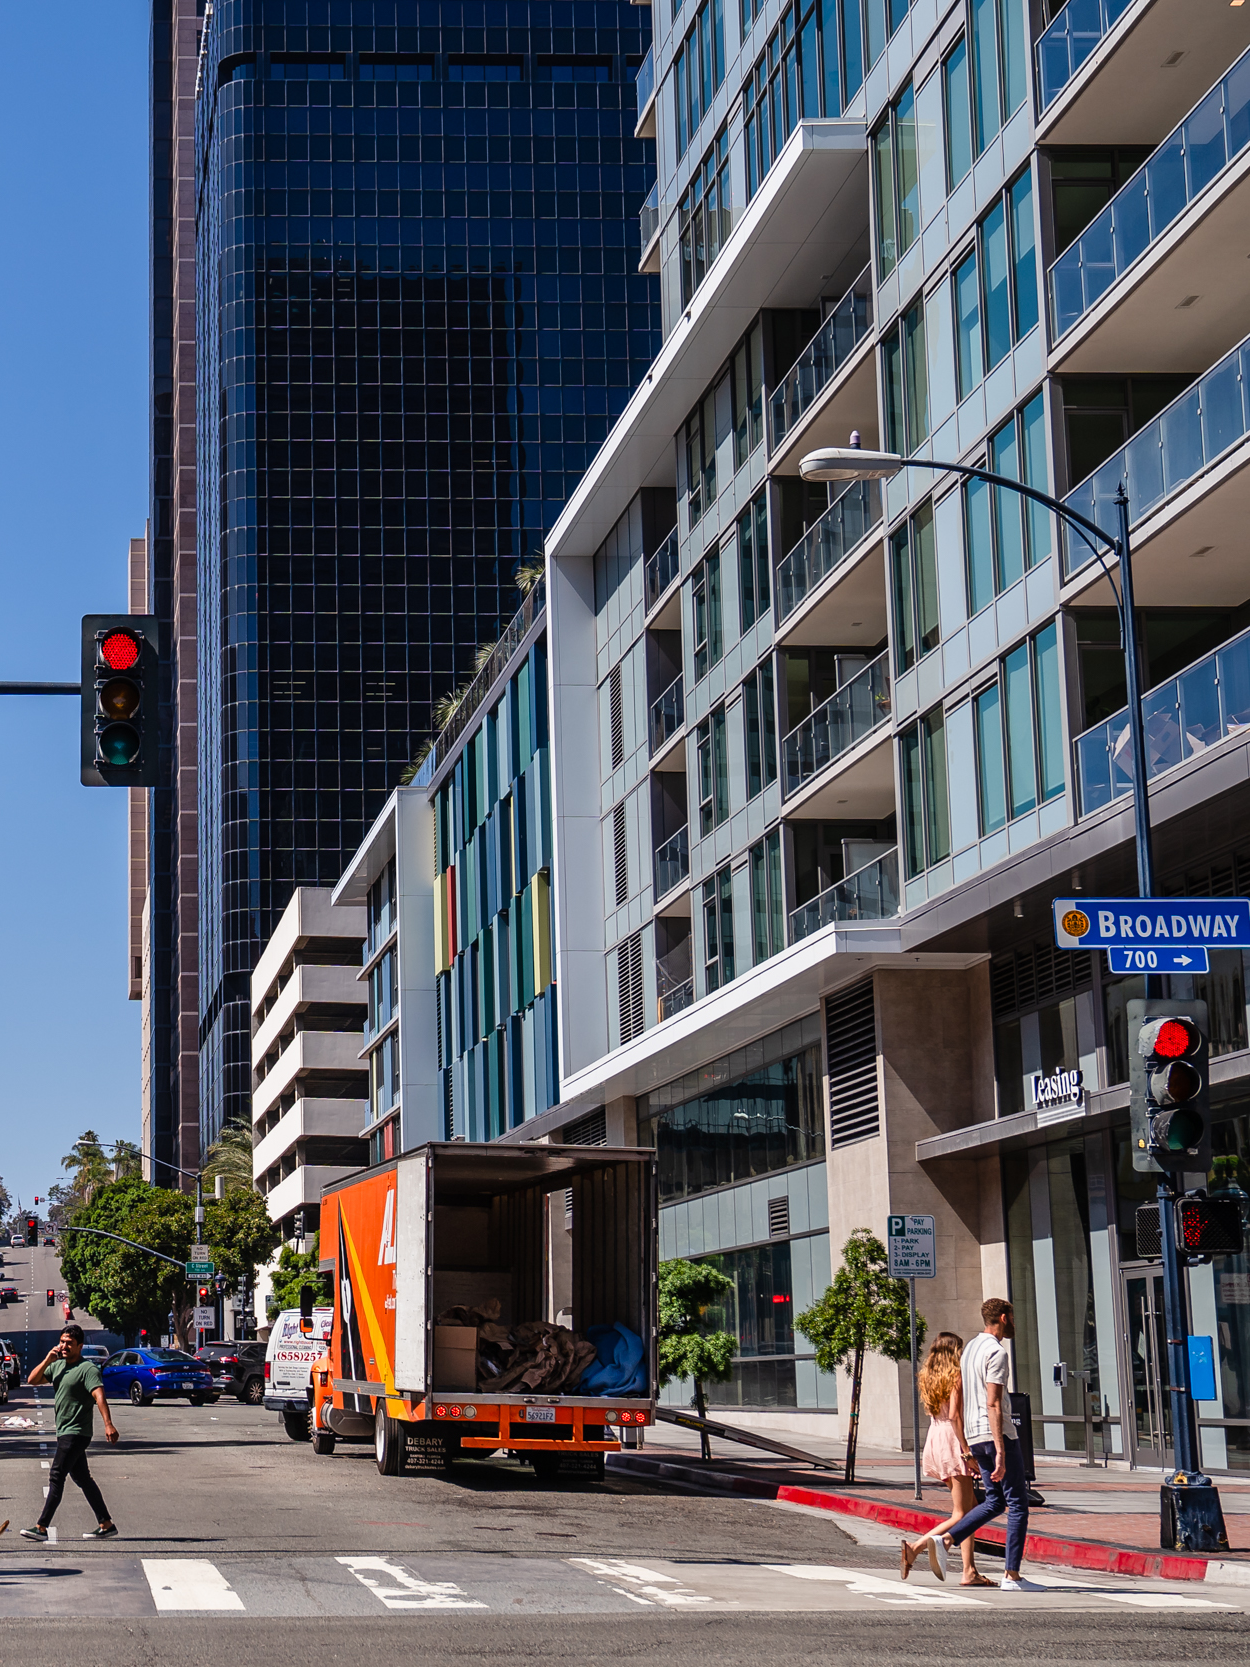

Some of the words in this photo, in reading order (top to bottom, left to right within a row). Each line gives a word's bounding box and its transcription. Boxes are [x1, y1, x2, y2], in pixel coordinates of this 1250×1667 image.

[1097, 910, 1240, 938] BROADWAY
[1123, 950, 1158, 968] 700
[1031, 1066, 1079, 1104] Leasing
[913, 1218, 925, 1226] PAY
[907, 1227, 932, 1235] PARKING
[407, 1437, 443, 1446] DEBARY
